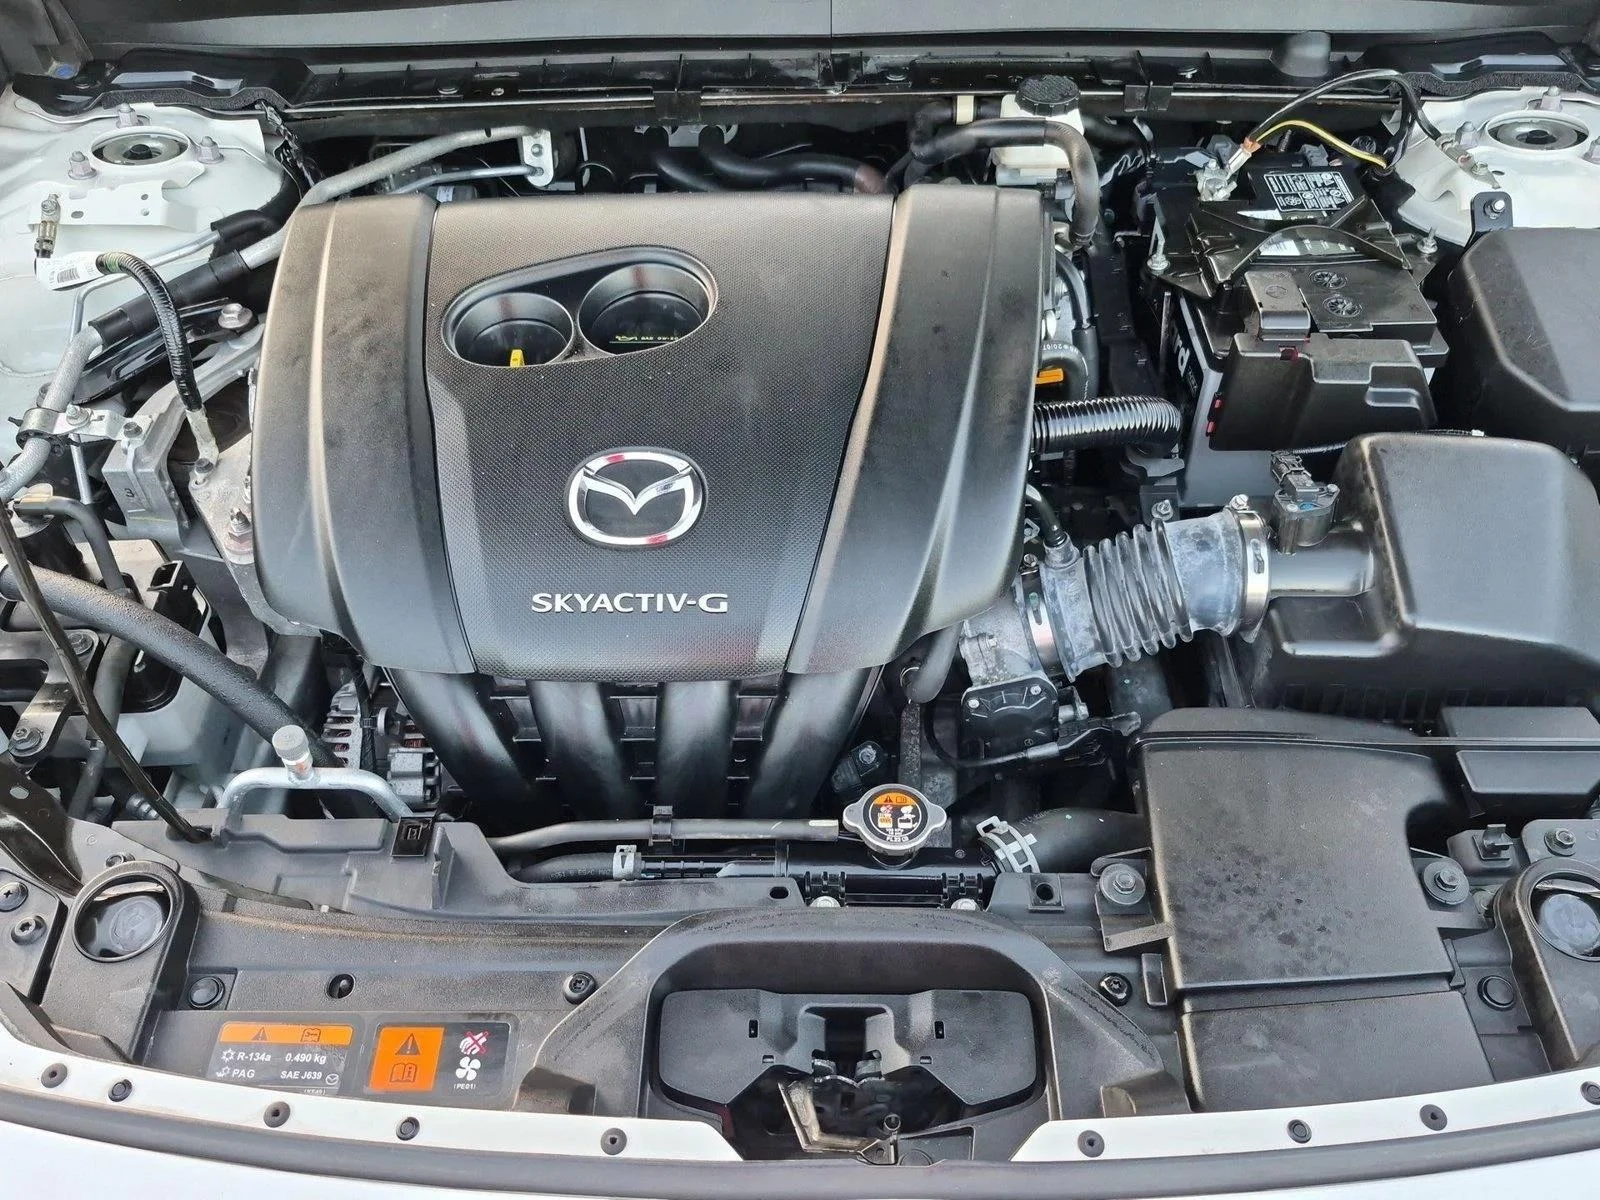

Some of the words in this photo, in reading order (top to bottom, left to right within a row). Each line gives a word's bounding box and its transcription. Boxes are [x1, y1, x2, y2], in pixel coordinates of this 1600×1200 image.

[531, 593, 729, 613] SKYACTIV-G
[237, 1051, 272, 1062] R-134a
[285, 1052, 312, 1062] 0.490
[313, 1052, 327, 1065] kg
[232, 1069, 256, 1079] PAG
[280, 1070, 300, 1079] SAE
[301, 1071, 322, 1080] J639
